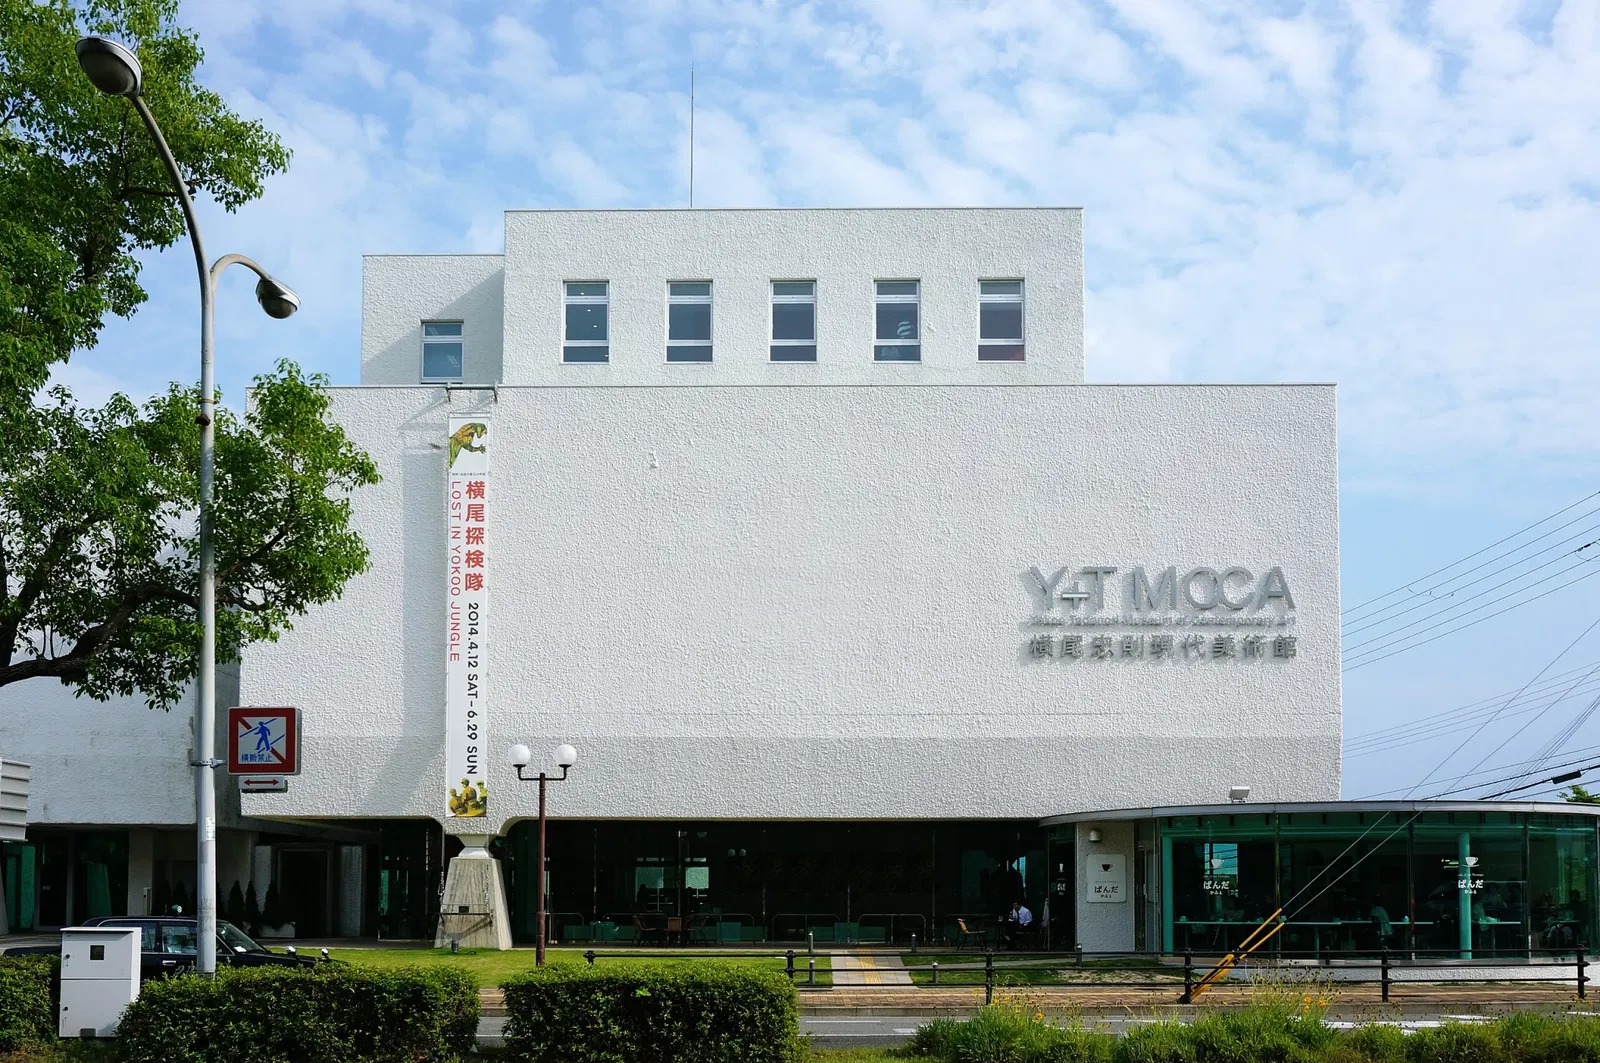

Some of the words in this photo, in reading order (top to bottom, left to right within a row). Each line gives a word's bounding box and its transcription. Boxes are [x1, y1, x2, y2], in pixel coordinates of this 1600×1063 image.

[451, 481, 462, 520] LOST
[451, 525, 461, 540] IN
[464, 480, 486, 592] 横尾探検隊
[450, 545, 461, 597] YOKOO
[1134, 566, 1296, 610] MOCA
[449, 602, 460, 662] JUNGLE
[468, 602, 479, 668] 2014.4.12
[1028, 634, 1297, 659] 横尾忠則現代美術館
[241, 753, 273, 763] 横断禁止
[466, 745, 478, 775] SUN
